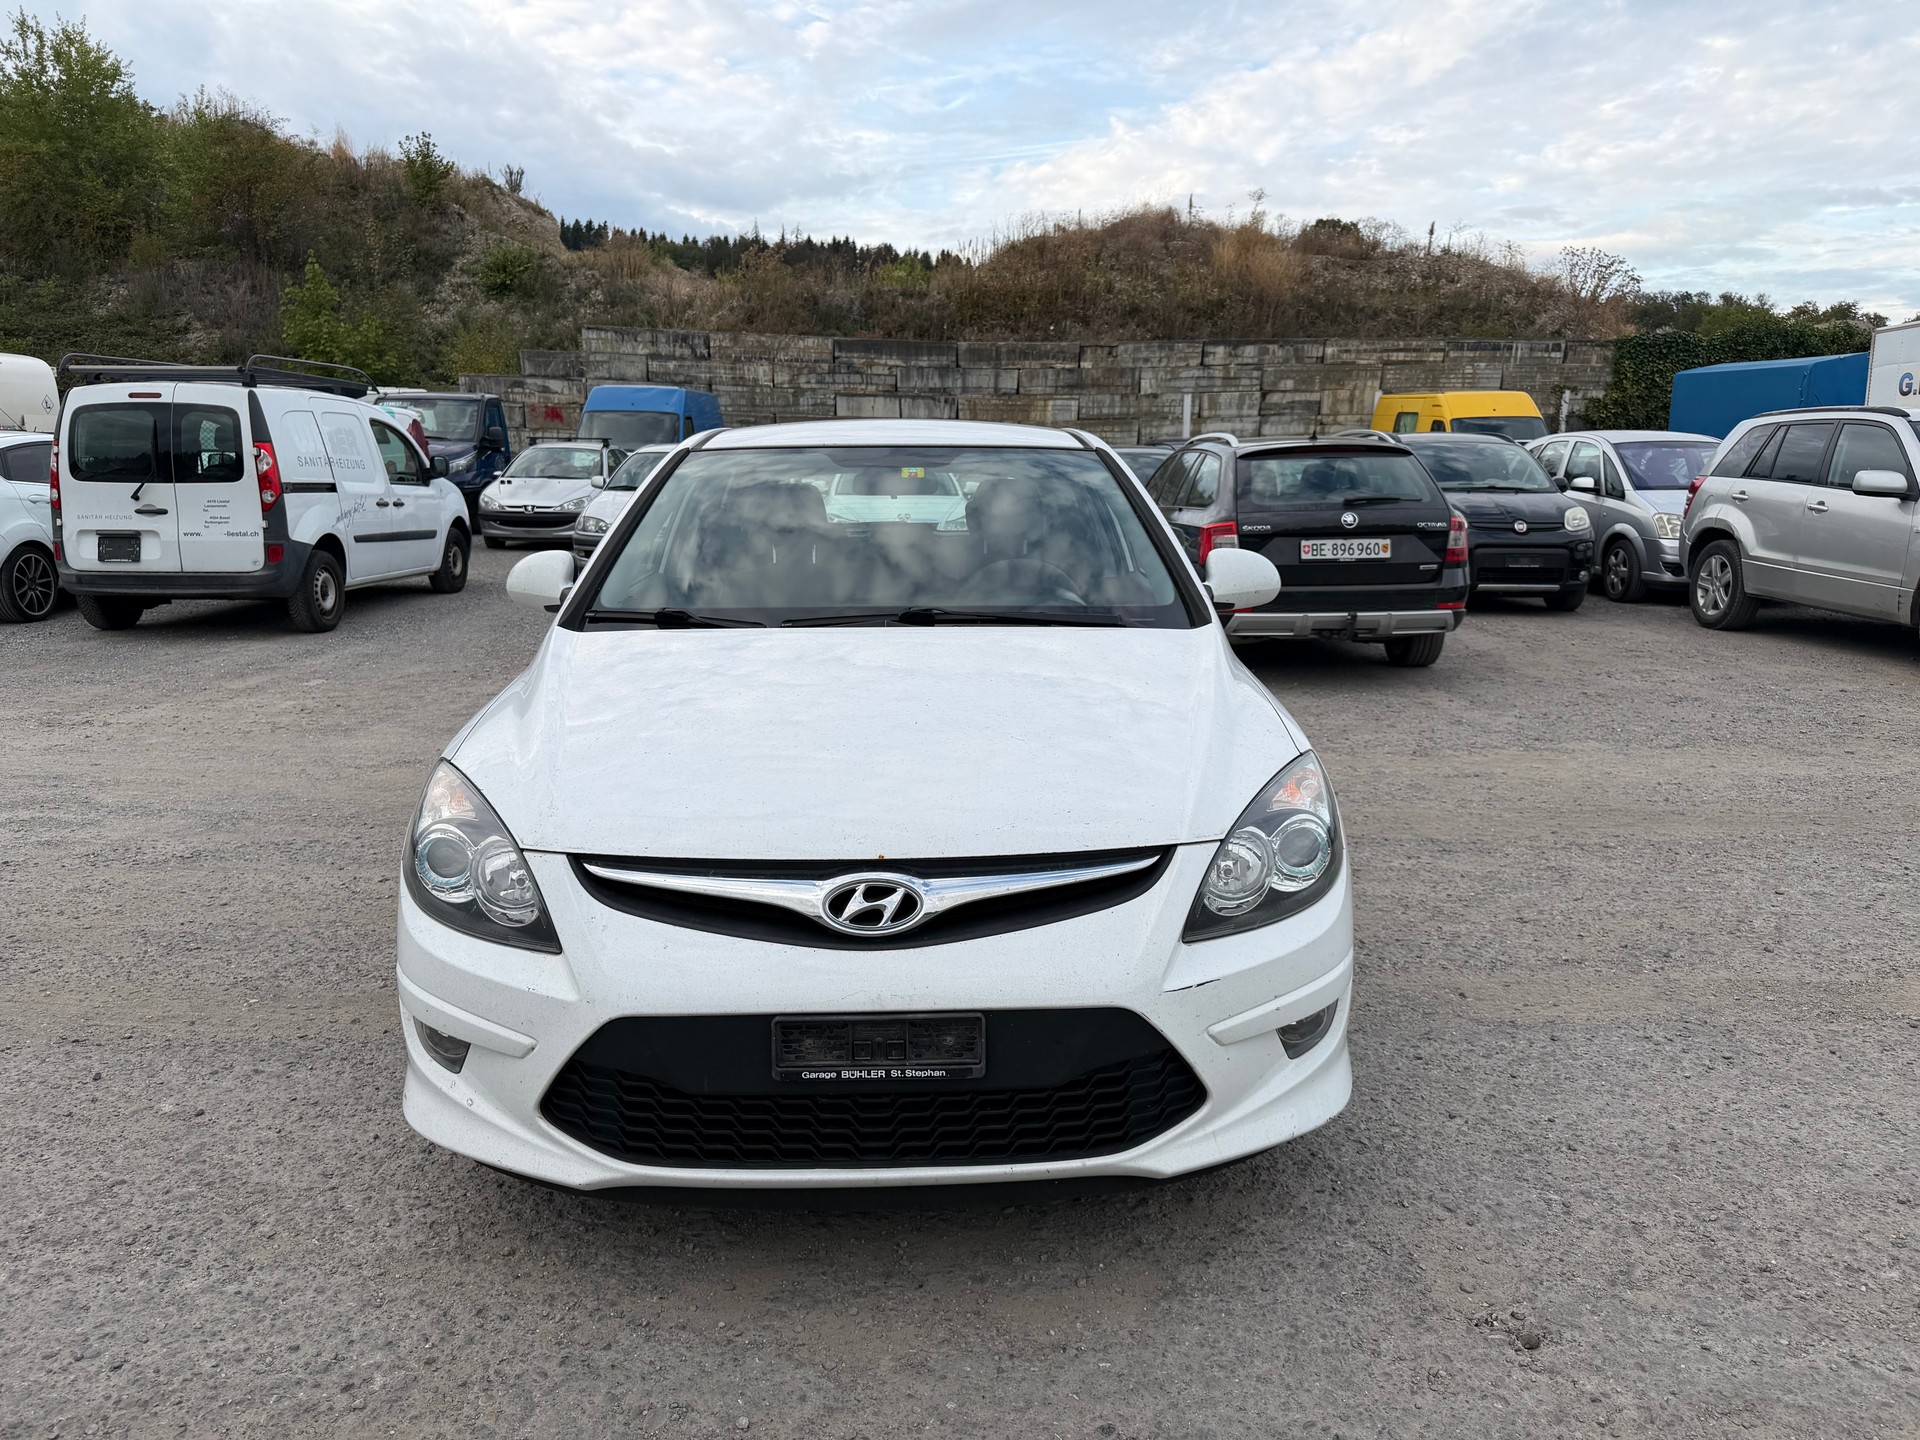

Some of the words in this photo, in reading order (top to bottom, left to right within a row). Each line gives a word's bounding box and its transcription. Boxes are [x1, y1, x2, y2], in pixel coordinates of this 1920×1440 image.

[1899, 372, 1920, 397] G.
[297, 455, 336, 468] SANITÄR
[801, 1071, 837, 1080] Garage
[841, 1070, 886, 1079] BÜHLER
